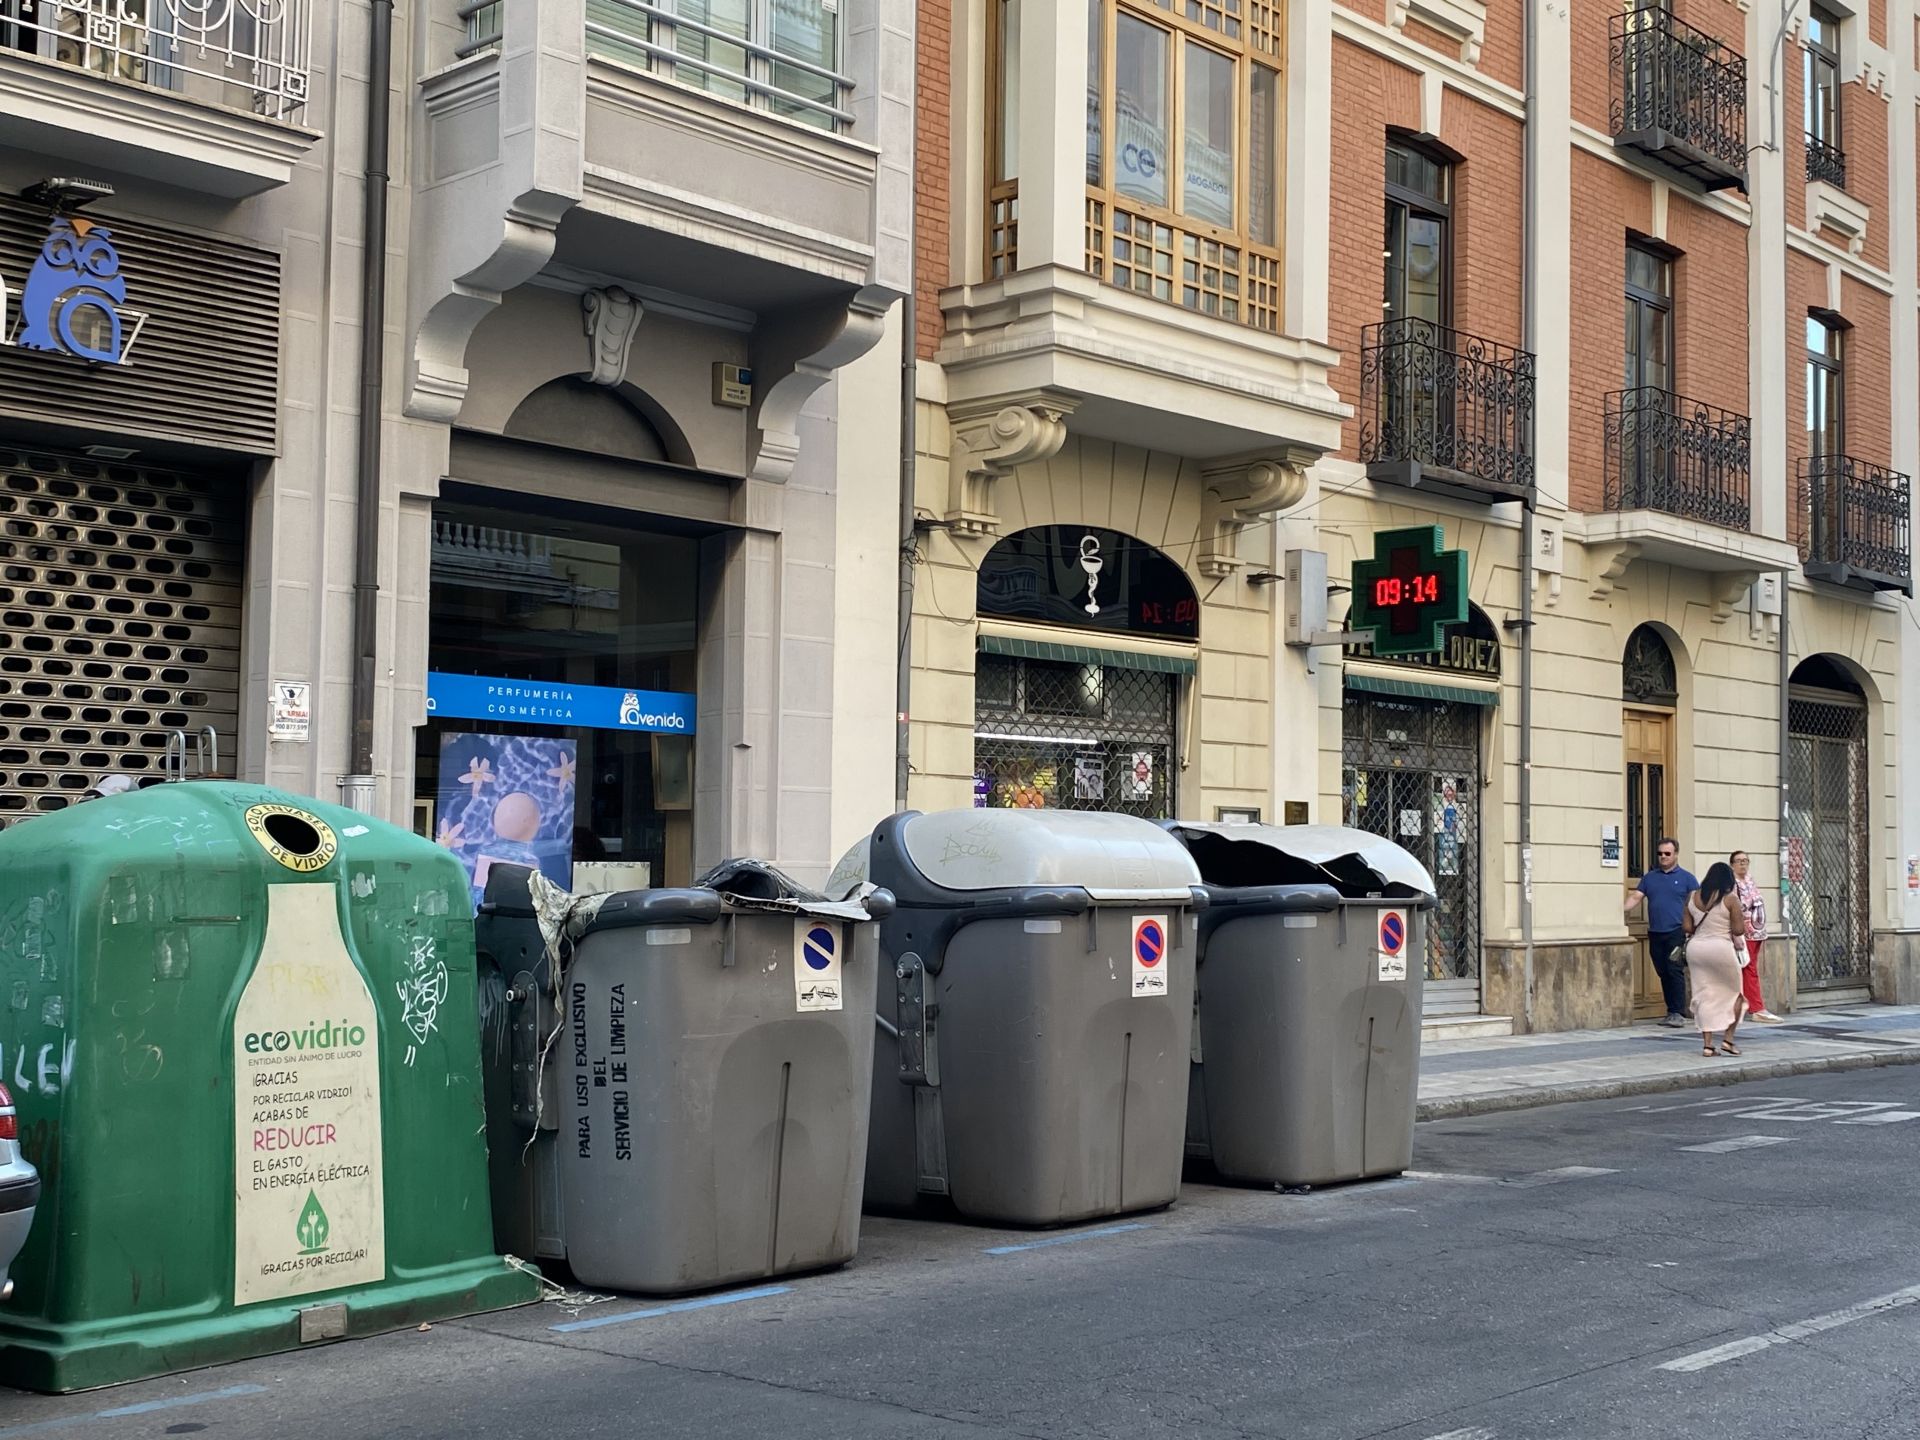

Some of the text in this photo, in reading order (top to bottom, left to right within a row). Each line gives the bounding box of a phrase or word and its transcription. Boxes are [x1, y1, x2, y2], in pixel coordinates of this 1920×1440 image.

[1187, 173, 1228, 196] ABOGADOS
[1376, 574, 1438, 606] 09:14
[1427, 634, 1498, 673] LOREZ
[488, 686, 573, 701] PERFUMERÍA
[488, 704, 573, 719] COSMÉTICA
[626, 709, 685, 729] avenida
[247, 805, 330, 832] SOLO ENVASES
[269, 842, 335, 869] DE VIDRIO
[244, 1018, 366, 1053] ecovidrio
[248, 1050, 362, 1067] ENTIDAD SIN ÁNIMO DE LUCRO
[573, 982, 591, 1159] PARA USO EXCLUSIVO
[610, 983, 632, 1161] SERVICIO DE LIMPIEZA
[253, 1086, 352, 1105] POR RECICLAR VIDRIO!
[252, 1106, 309, 1123] ACABAS DE
[253, 1123, 337, 1152] REDUCIR
[253, 1155, 303, 1173] EL GASTO
[253, 1163, 369, 1190] EN ENERGÍA ELÉCTRICA
[306, 1254, 323, 1269] POR
[324, 1248, 368, 1265] RECICLAR!
